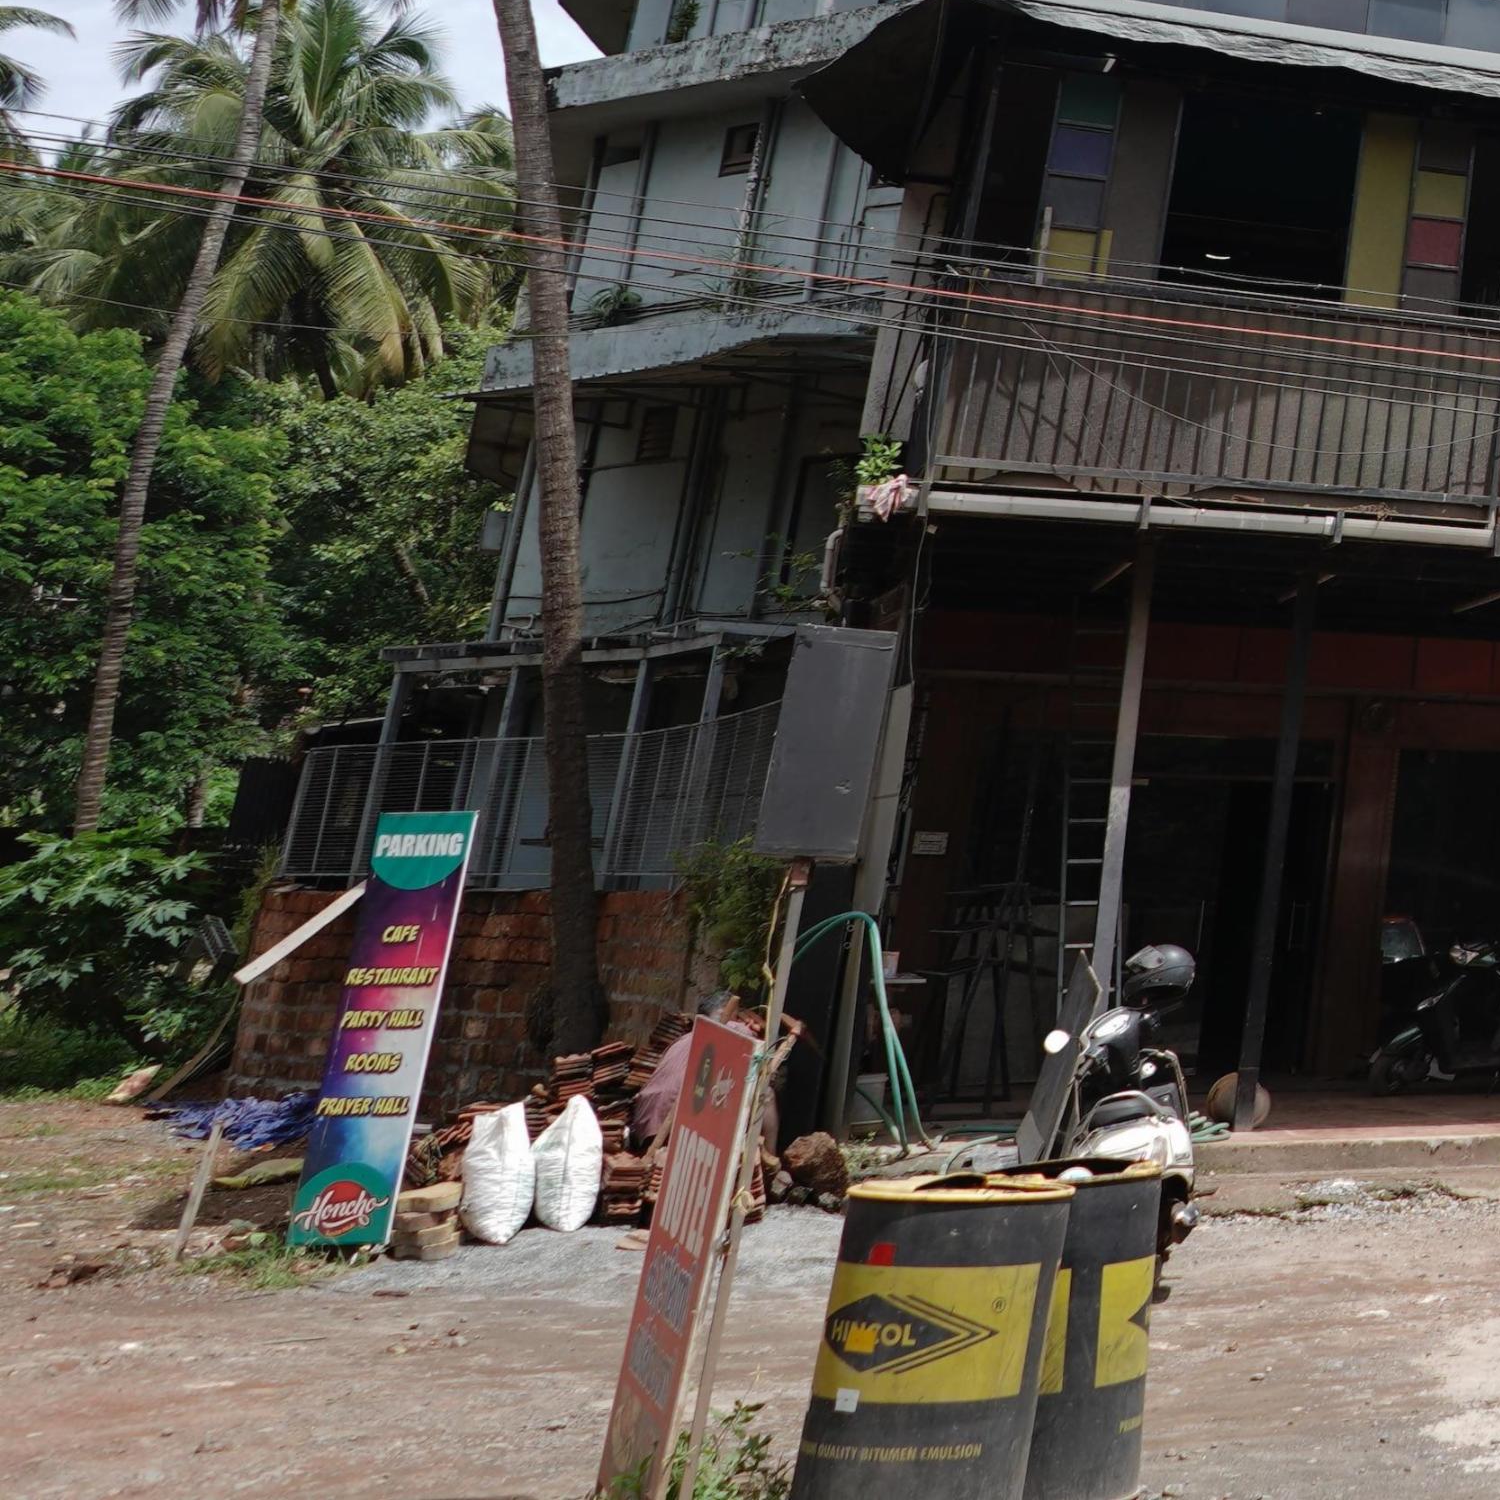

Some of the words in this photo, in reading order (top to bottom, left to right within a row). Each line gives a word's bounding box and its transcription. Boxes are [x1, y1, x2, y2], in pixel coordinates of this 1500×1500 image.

[374, 832, 465, 858] PARKING
[382, 925, 420, 943] CAFE
[345, 966, 439, 987] RESTAURANT
[340, 1010, 387, 1029] PARTY
[386, 1009, 424, 1029] HALL
[344, 1052, 403, 1073] ROOMS
[316, 1097, 373, 1116] PRAYER
[371, 1096, 411, 1116] HALL
[659, 1124, 721, 1258] HOTEL
[294, 1190, 389, 1231] Honcho
[817, 1443, 857, 1461] QUALITY
[859, 1445, 917, 1462] BITUMEN
[920, 1442, 983, 1461] EMULSION
